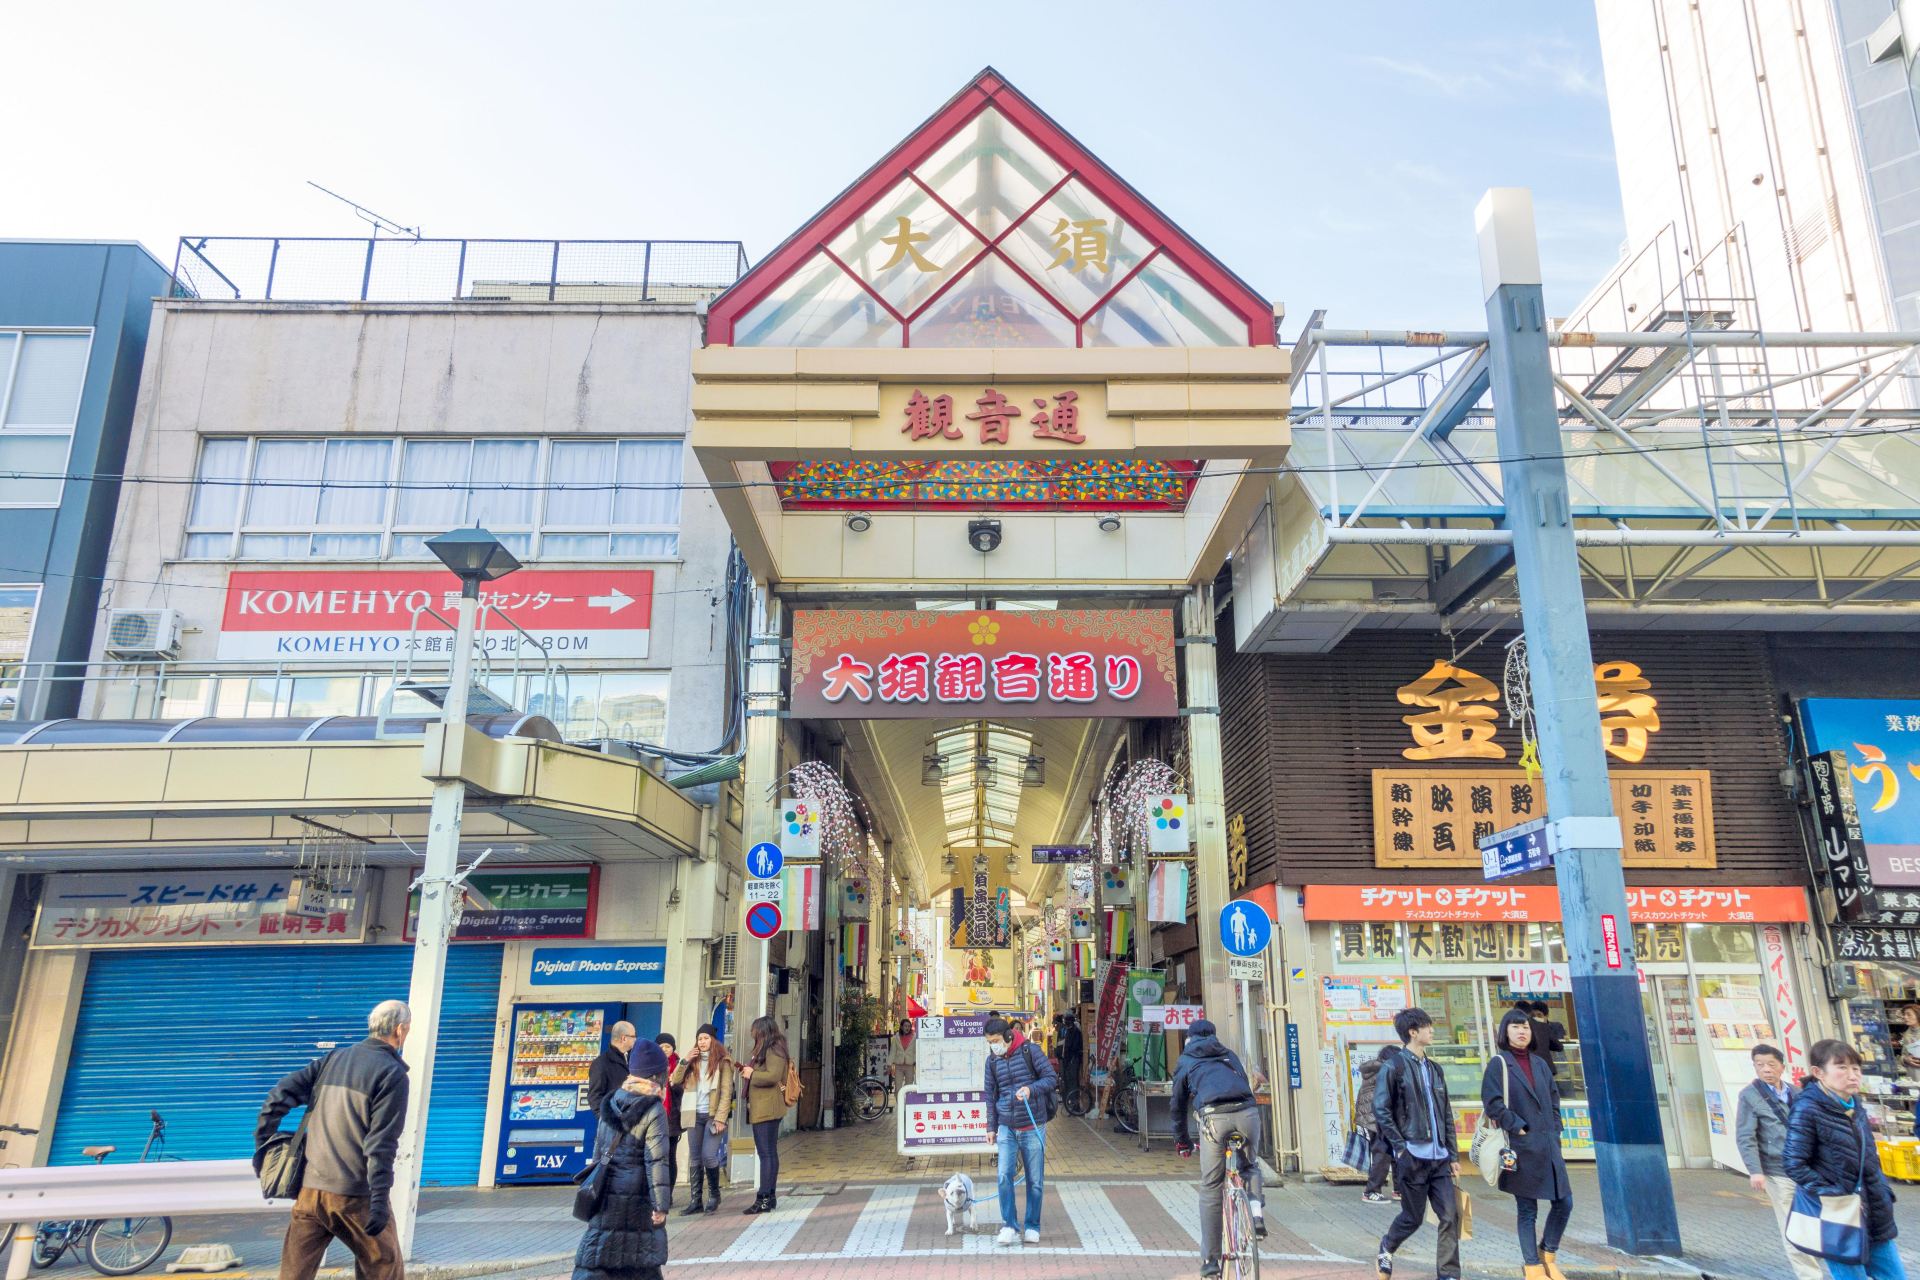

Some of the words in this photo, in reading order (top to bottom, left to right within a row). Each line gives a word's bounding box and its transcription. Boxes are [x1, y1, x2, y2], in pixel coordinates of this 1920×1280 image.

[902, 389, 1086, 444] 観音通
[239, 590, 432, 614] KOMEHYO
[277, 636, 399, 652] KOMEHYO
[821, 652, 1142, 702] 大須観音通り
[1510, 784, 1534, 824] 野
[1391, 783, 1414, 851] 新幹線
[1431, 783, 1456, 851] 映画
[1670, 784, 1696, 852] 株主優待券
[490, 883, 588, 899] フジカラー
[461, 916, 499, 927] Digital
[502, 914, 536, 925] Photo
[540, 914, 583, 924] Service
[1502, 910, 1528, 919] 大須店
[1728, 911, 1754, 921] 大須店
[535, 961, 575, 976] Digital
[578, 960, 613, 972] Photo
[615, 960, 660, 973] Express
[1511, 969, 1563, 987] リフト
[921, 1018, 942, 1029] K-3
[953, 1019, 983, 1027] Welcome
[532, 1098, 572, 1109] PEPSI
